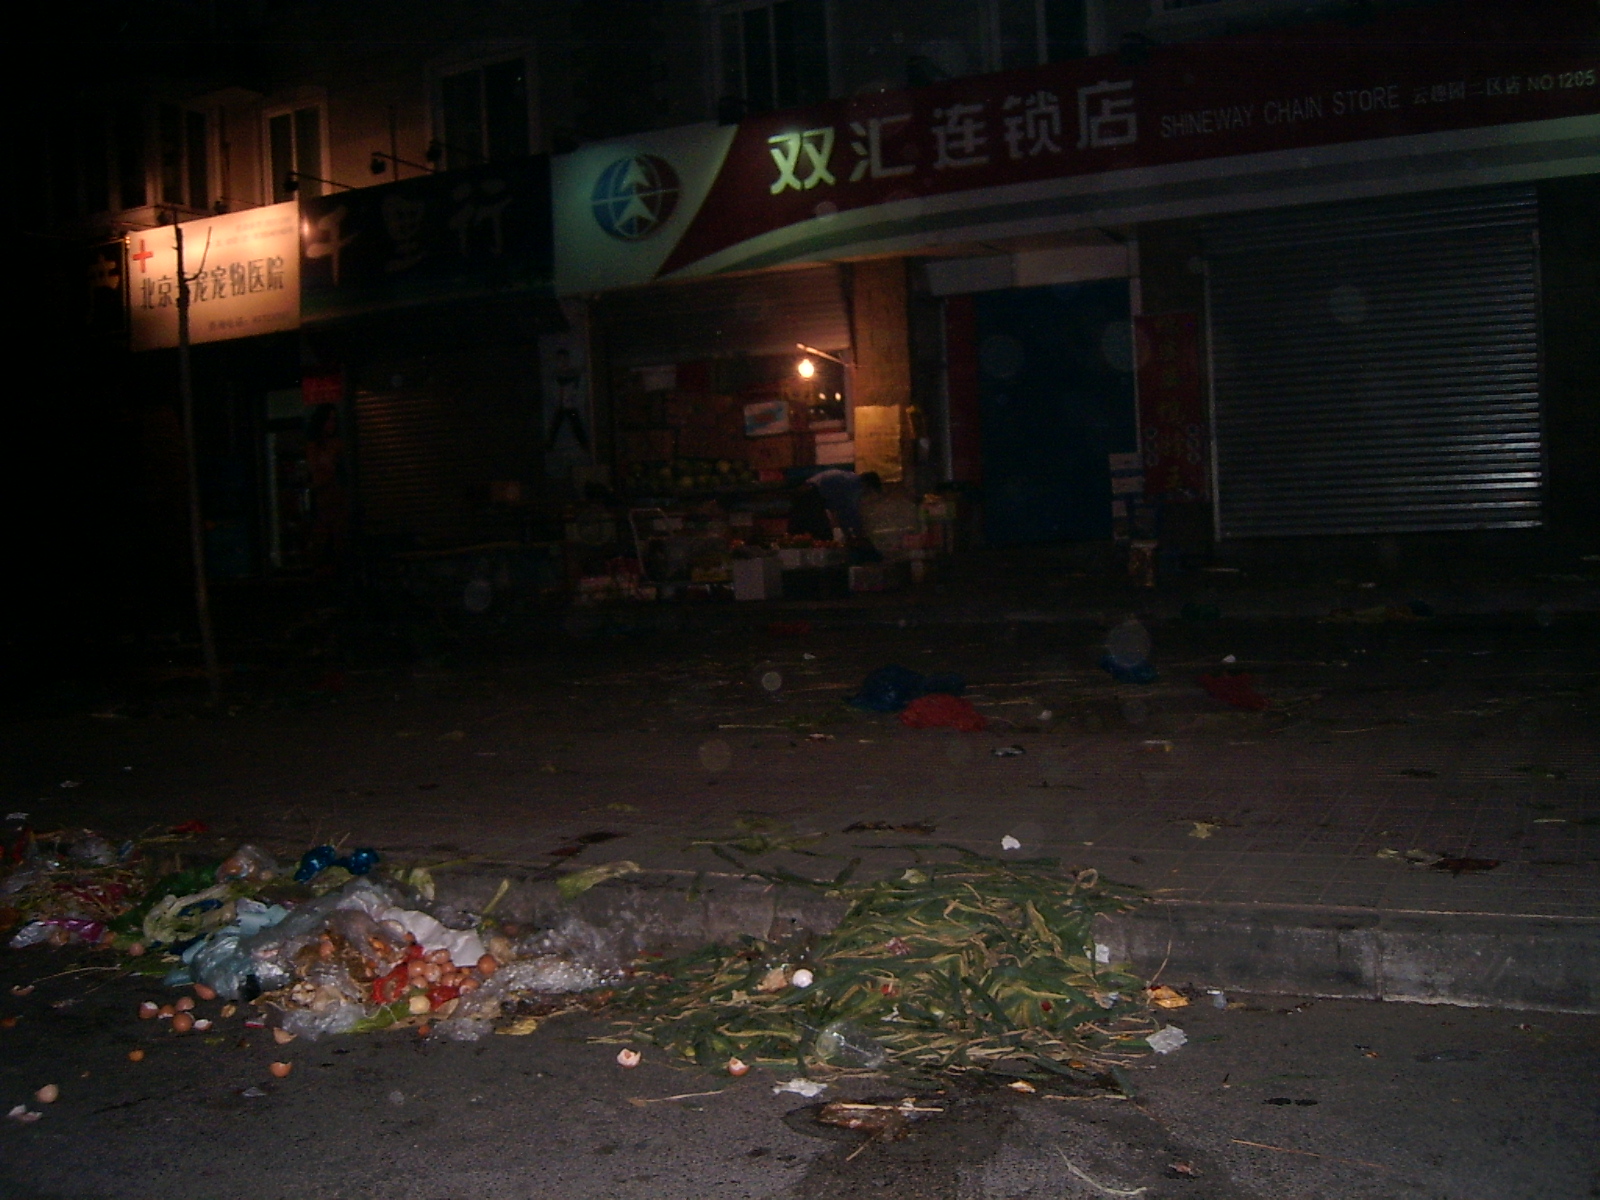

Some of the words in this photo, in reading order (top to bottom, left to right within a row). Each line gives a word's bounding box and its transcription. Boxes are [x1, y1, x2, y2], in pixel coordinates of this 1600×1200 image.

[1558, 69, 1597, 89] 1205
[766, 79, 1138, 195] 双汇连锁店
[1160, 104, 1254, 138] SHINEWAY
[1263, 96, 1323, 126] CHAIN
[1332, 85, 1400, 116] STORE
[140, 256, 284, 310] 北京宠宠物医院
